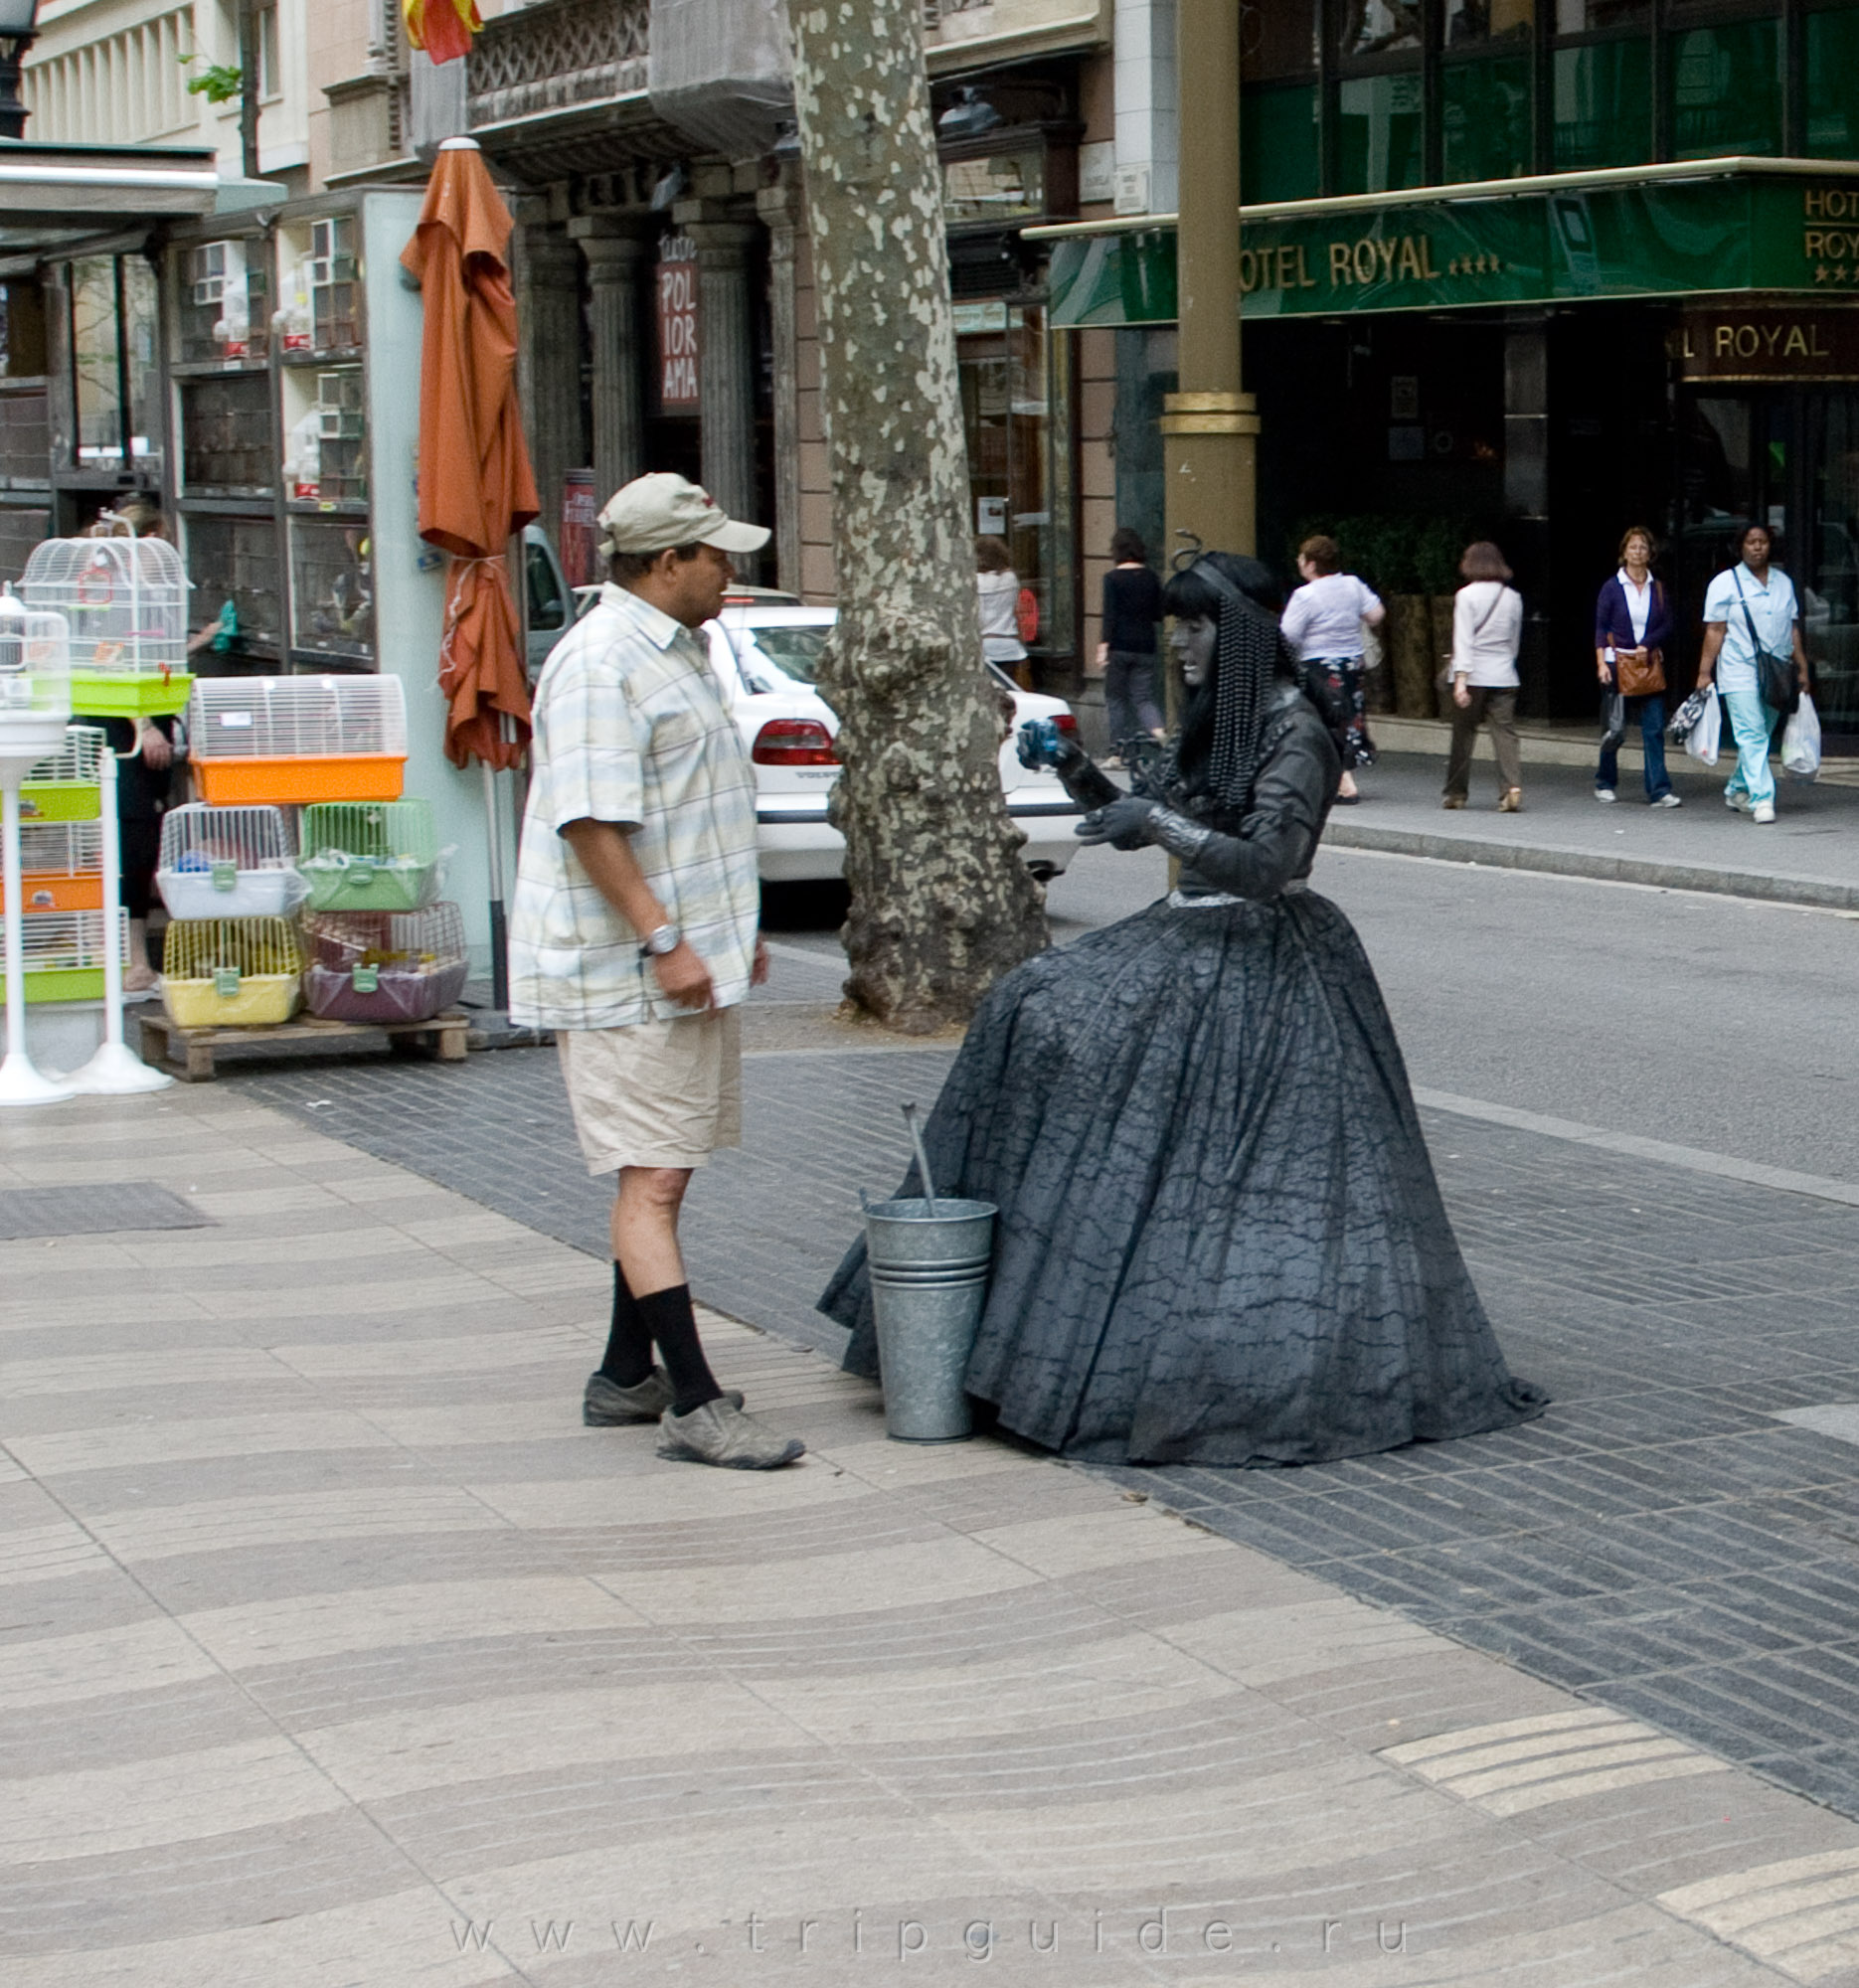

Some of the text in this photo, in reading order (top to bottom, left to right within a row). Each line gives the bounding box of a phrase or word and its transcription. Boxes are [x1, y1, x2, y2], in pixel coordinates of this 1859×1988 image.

[1241, 235, 1440, 291] OTEL ROYAL
[662, 269, 696, 313] POL
[663, 314, 696, 355] IOR
[1715, 324, 1829, 358] ROYAL
[663, 357, 698, 398] AMA
